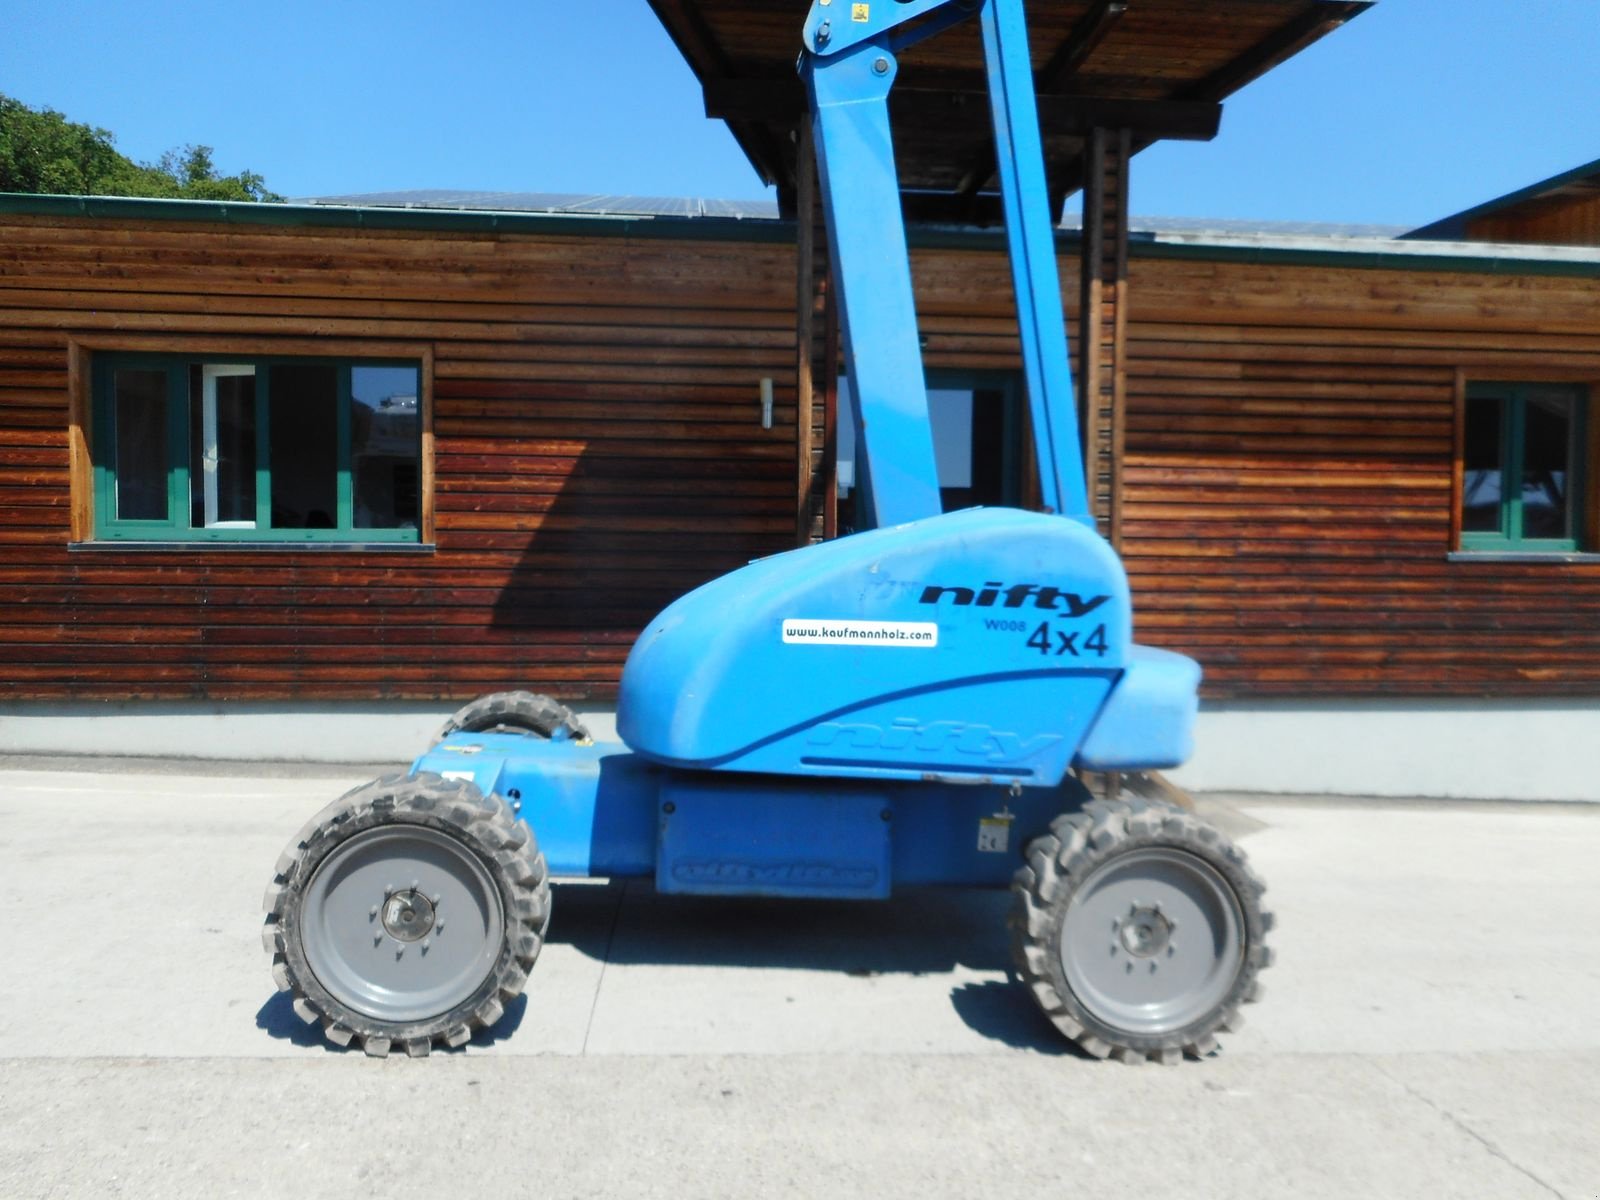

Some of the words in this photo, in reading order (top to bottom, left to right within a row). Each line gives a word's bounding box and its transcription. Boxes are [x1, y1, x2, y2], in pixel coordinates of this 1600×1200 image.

[918, 581, 1112, 618] nifty
[786, 626, 933, 641] www.kaufmannholz.com
[1026, 621, 1108, 657] 4x4
[806, 717, 1064, 763] nifty
